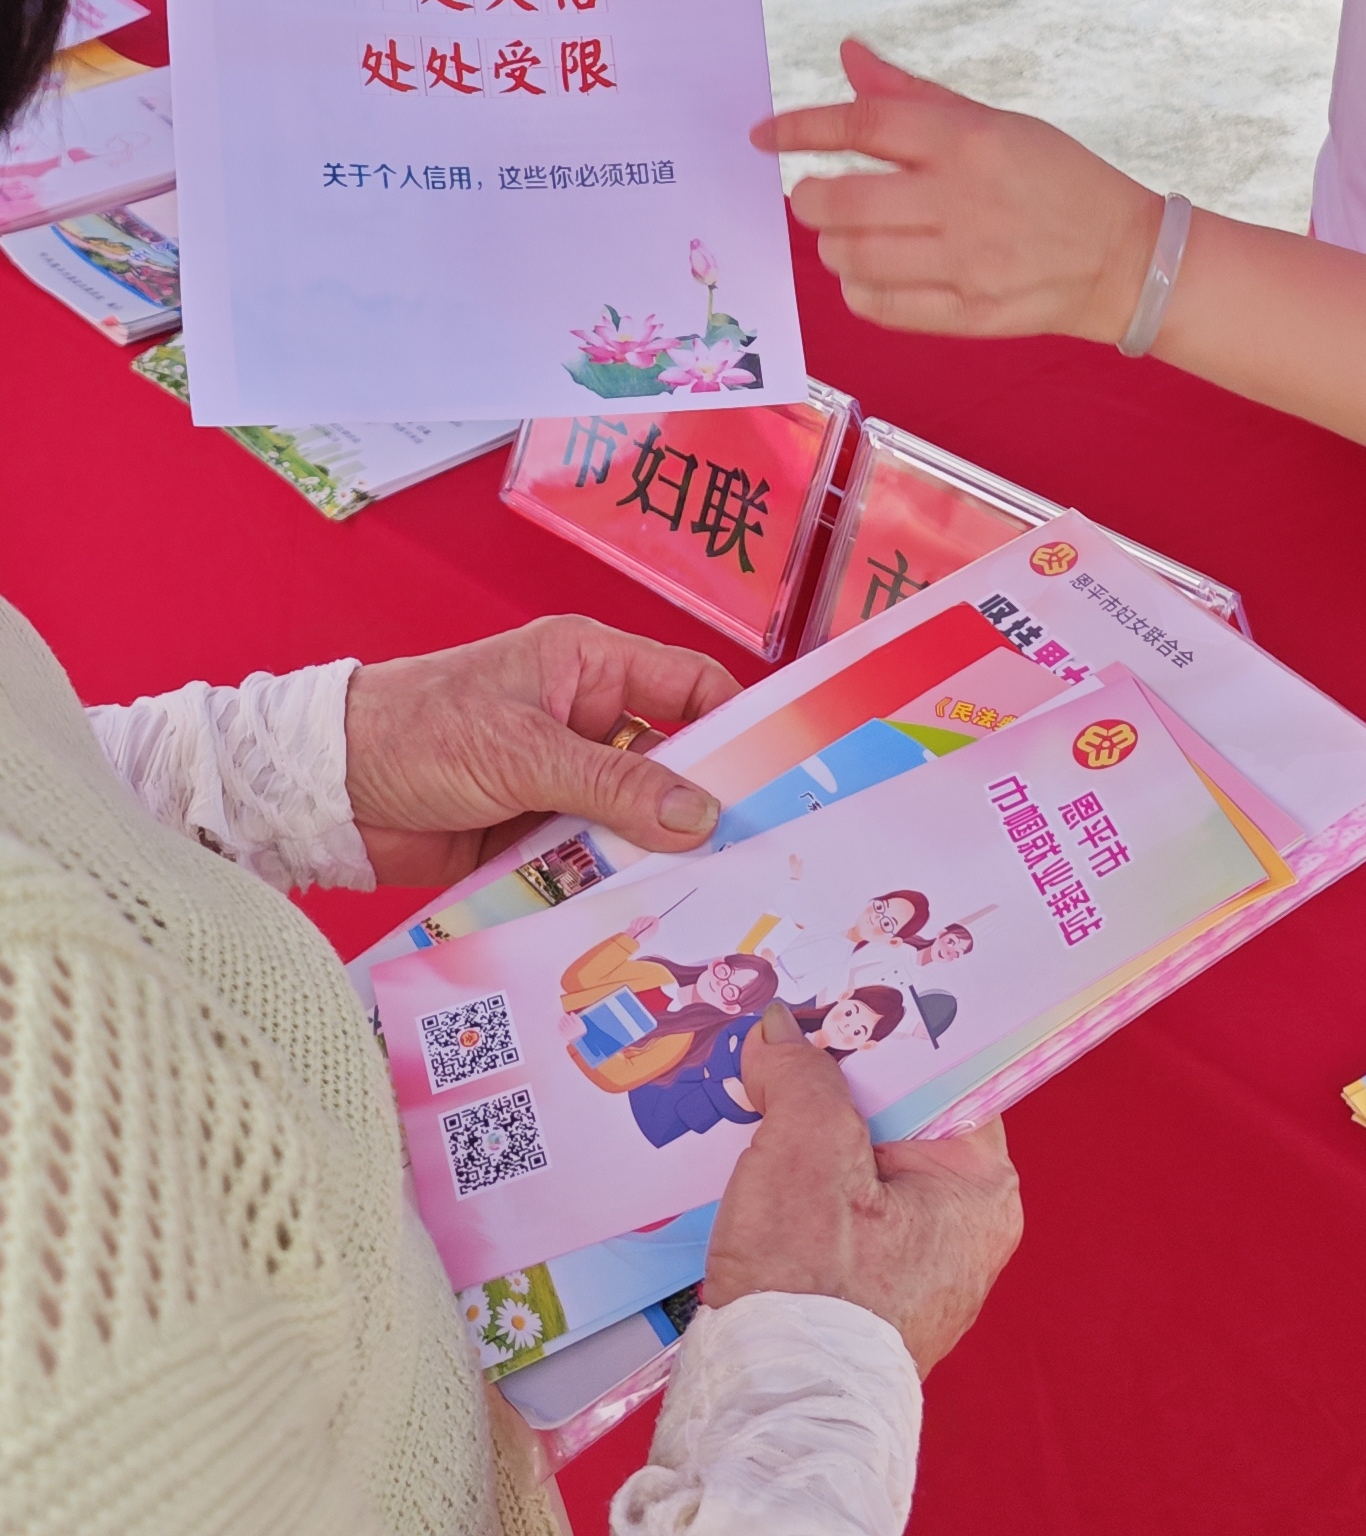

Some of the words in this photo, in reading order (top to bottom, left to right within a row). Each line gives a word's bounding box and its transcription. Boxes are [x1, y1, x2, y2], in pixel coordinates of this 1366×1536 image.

[361, 38, 617, 96] 处处受限
[322, 160, 677, 192] 关于个人信用，这些你必须知道
[563, 416, 771, 573] 市妇联
[1068, 572, 1195, 669] 恩平市妇女联合会
[988, 775, 1103, 946] 巾帼就业驿站
[1058, 791, 1131, 878] 恩平市
